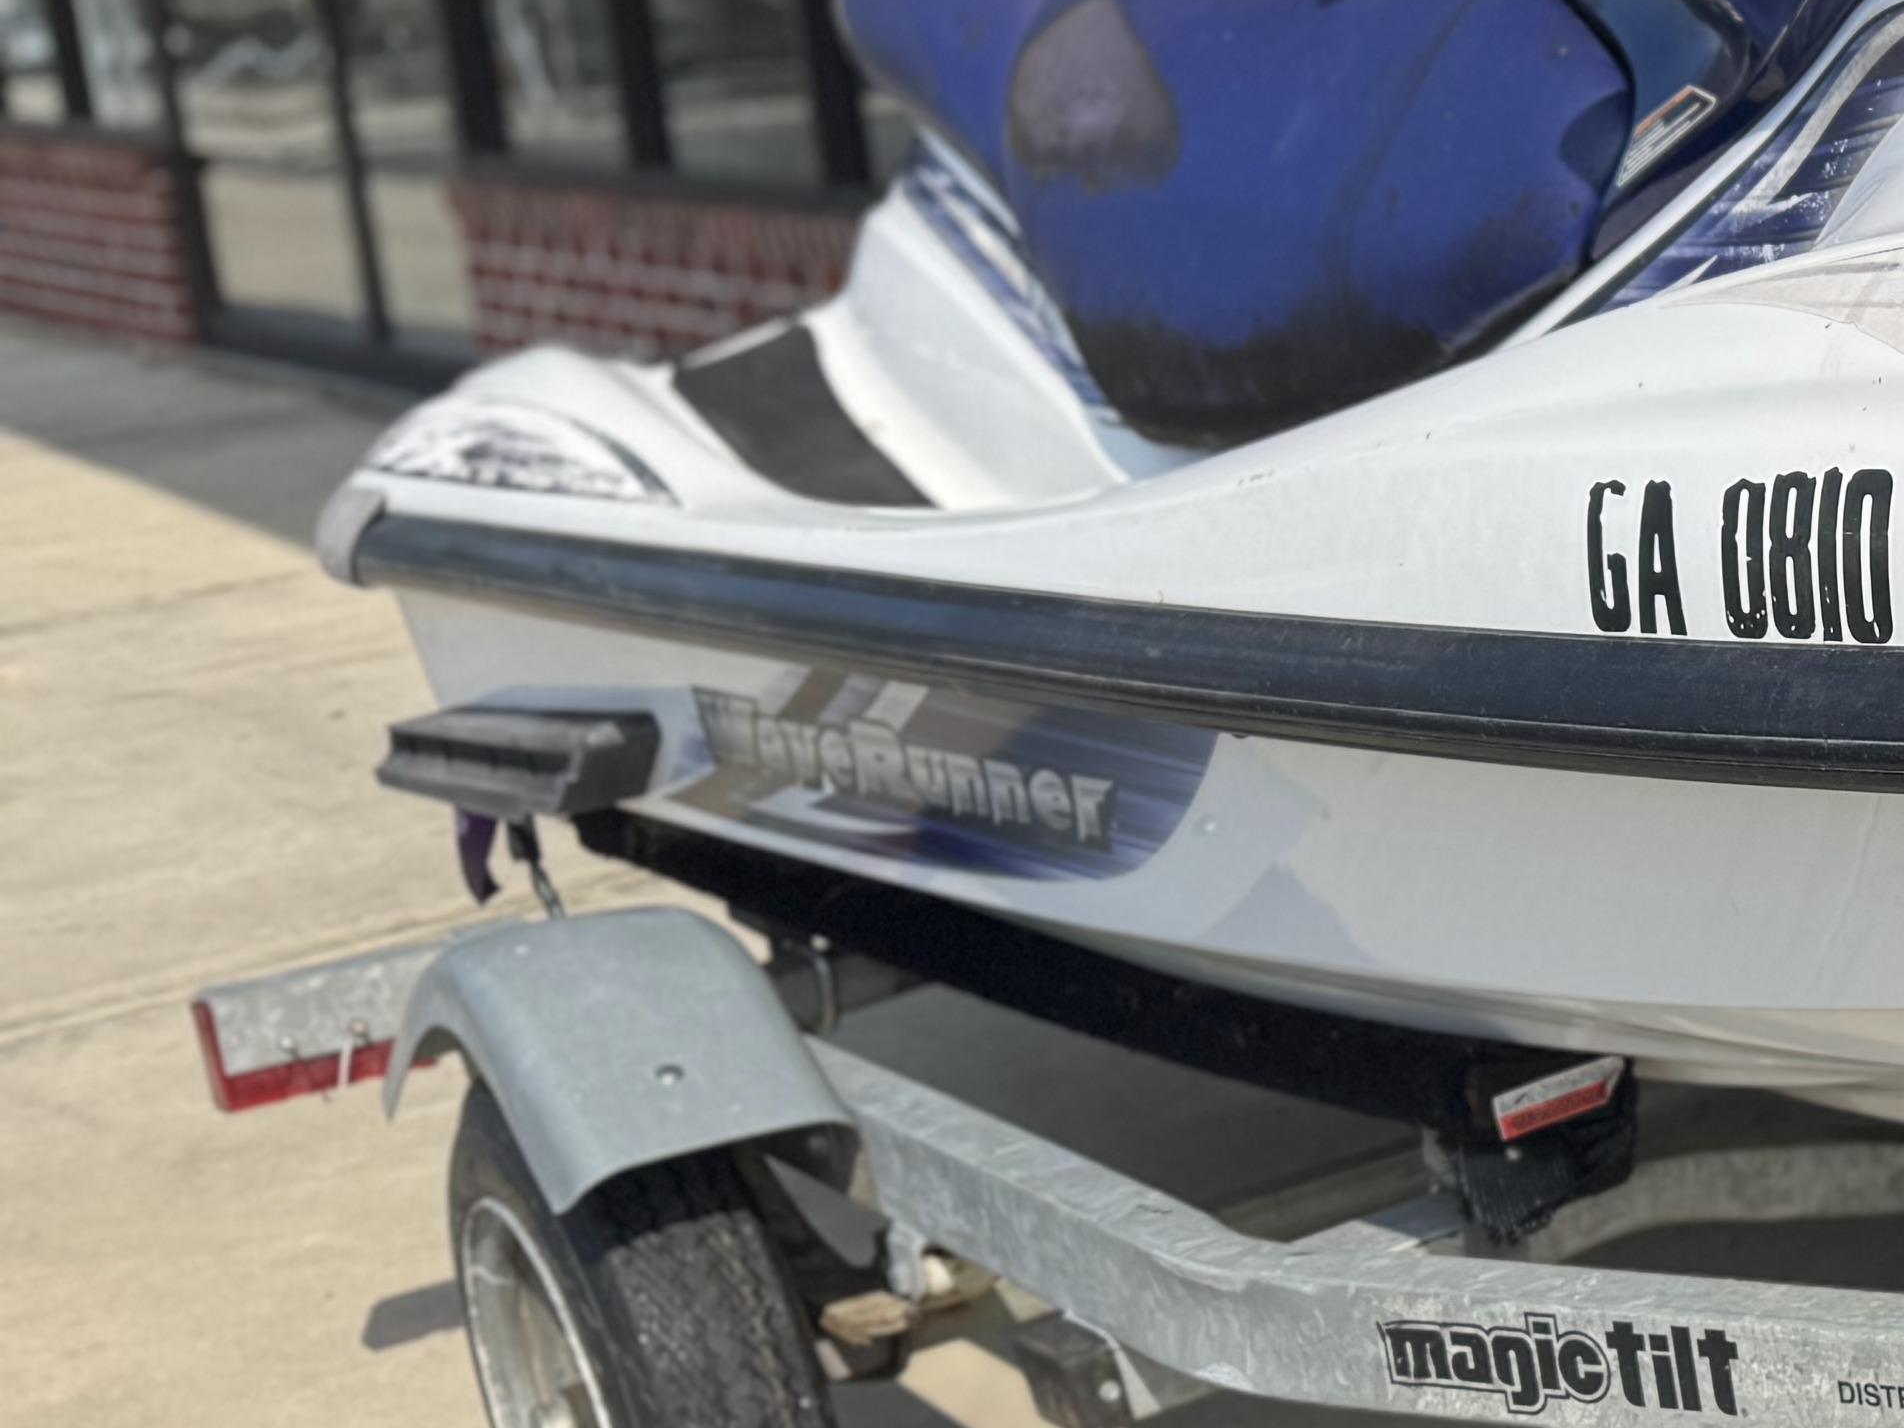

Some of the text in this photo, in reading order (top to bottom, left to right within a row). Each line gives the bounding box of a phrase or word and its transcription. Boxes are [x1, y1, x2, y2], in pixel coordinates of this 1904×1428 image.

[1587, 478, 1688, 636] GA
[1721, 466, 1894, 644] 0810
[693, 687, 1117, 852] WaveRunner
